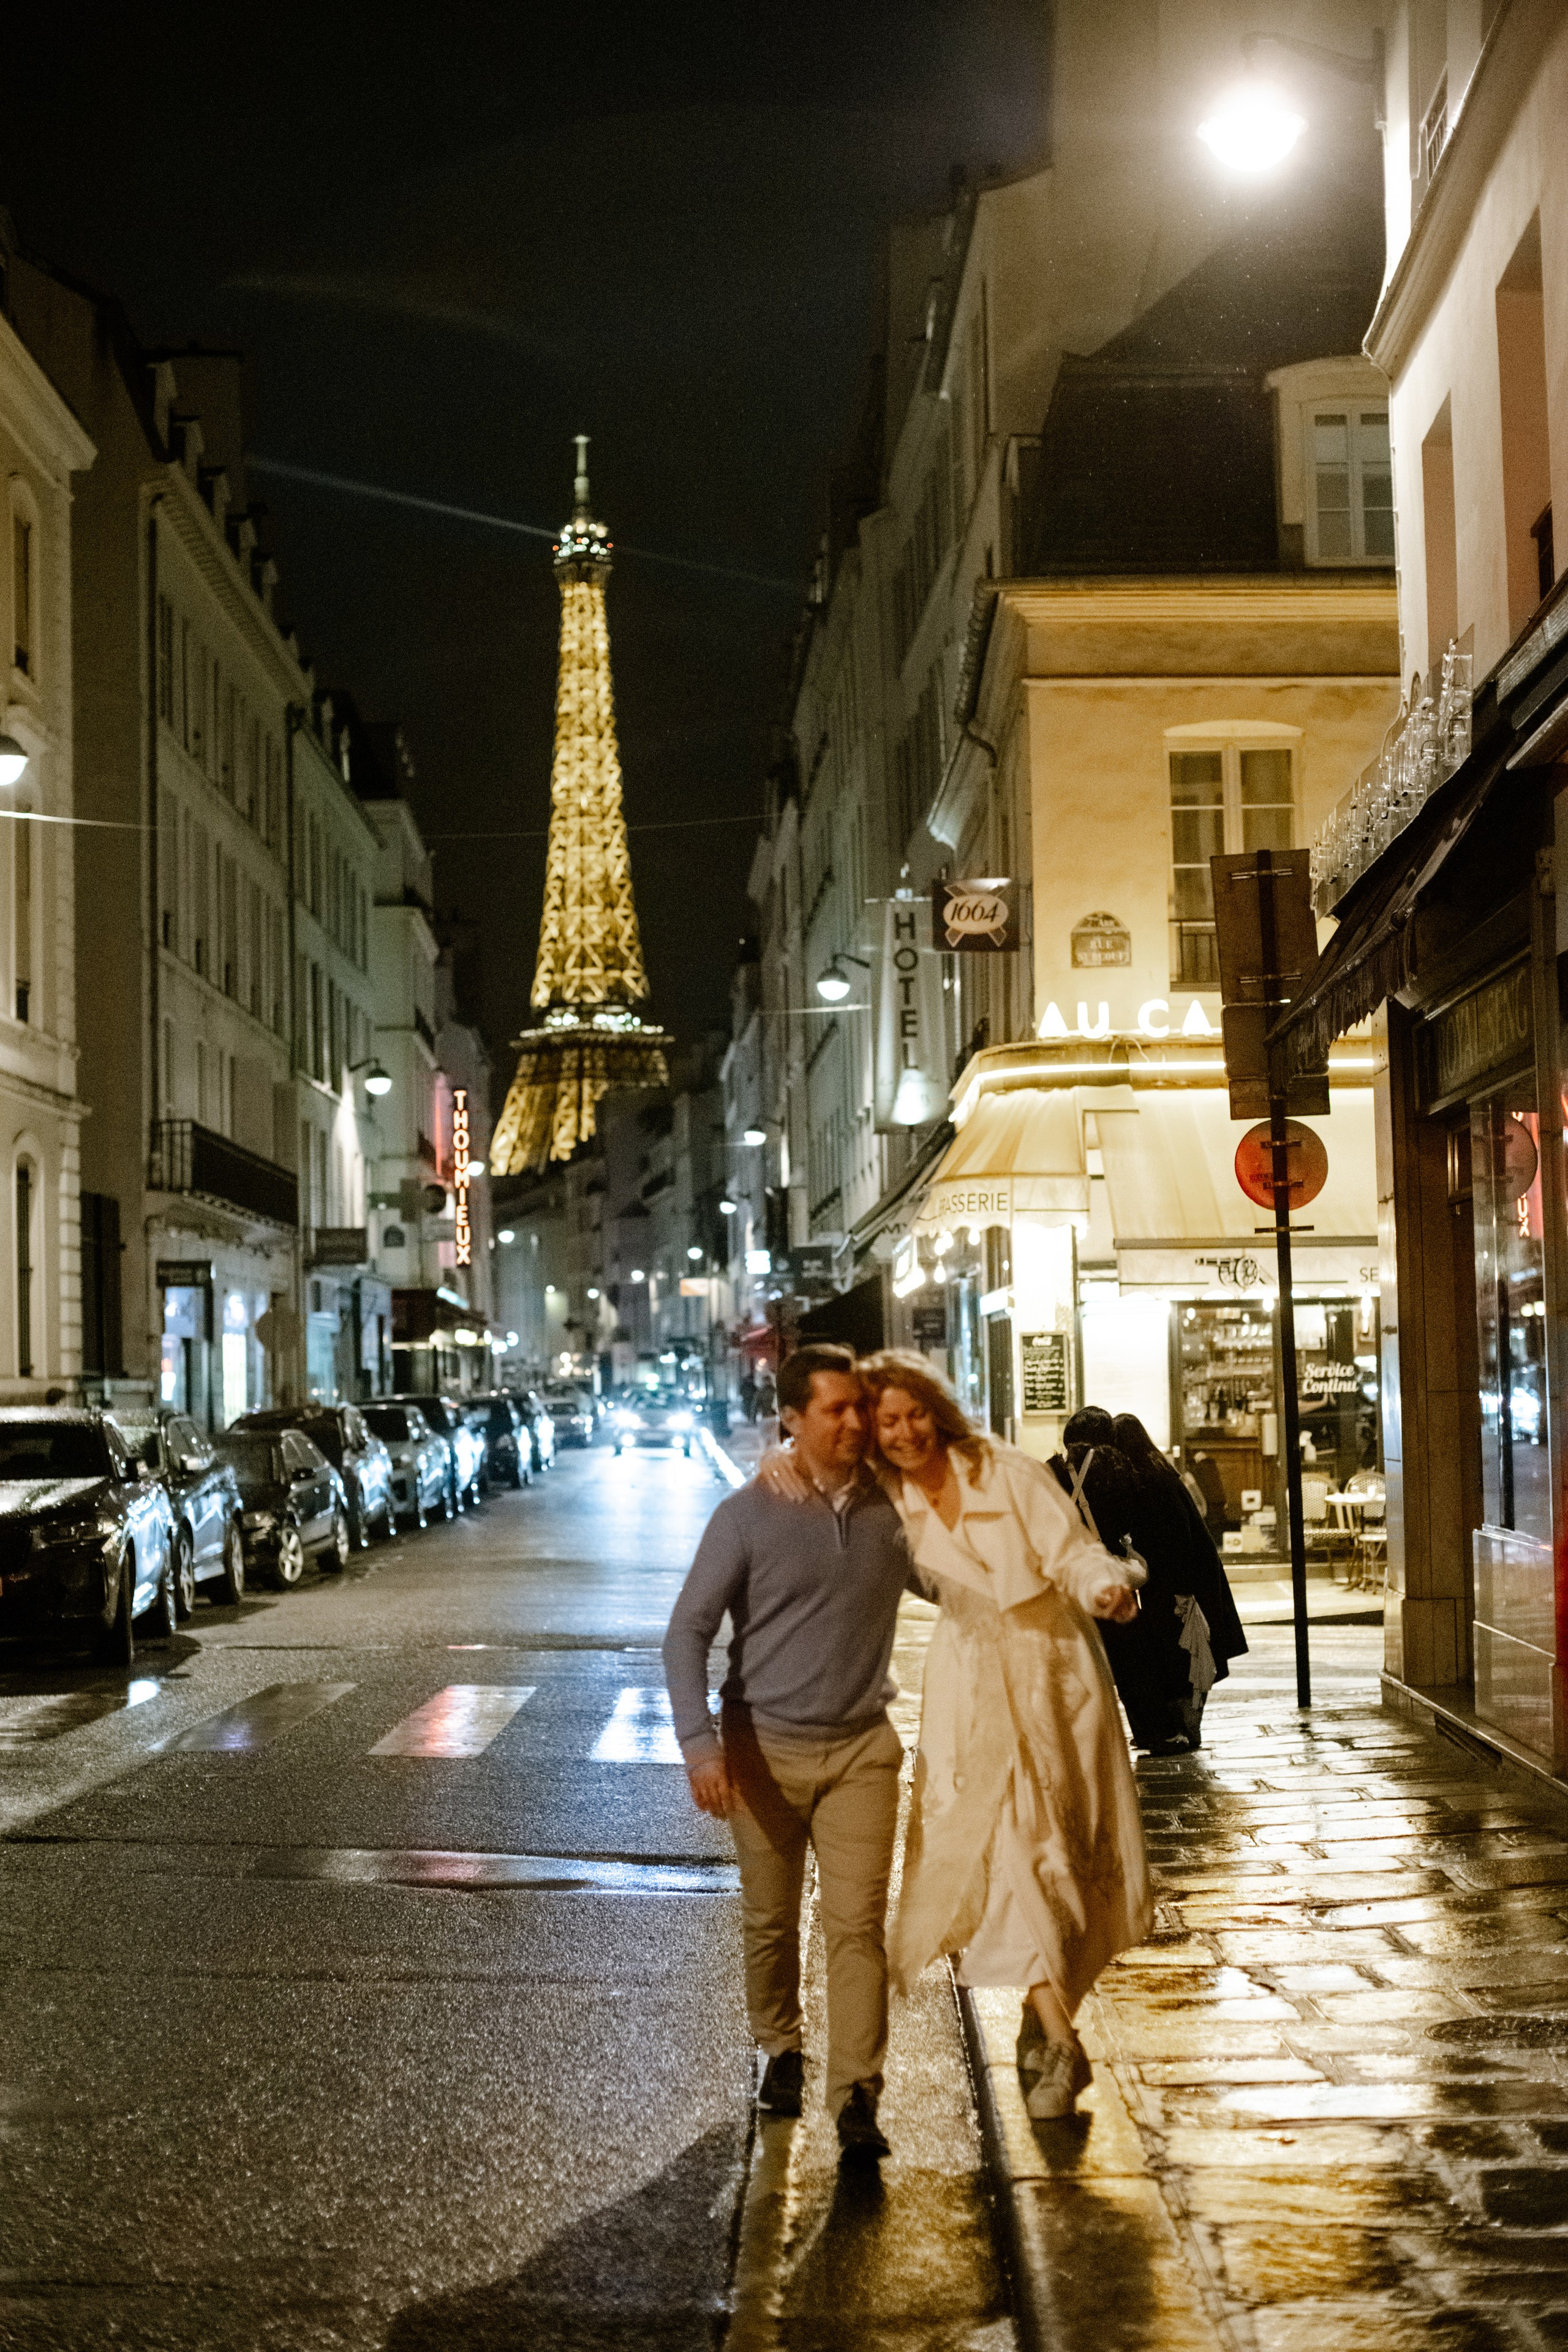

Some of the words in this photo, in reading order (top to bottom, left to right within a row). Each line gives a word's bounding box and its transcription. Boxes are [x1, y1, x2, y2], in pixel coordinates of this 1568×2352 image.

[951, 899, 1000, 922] 1664
[894, 912, 919, 1070] HOTEL
[1038, 1001, 1109, 1039] AU
[453, 1090, 470, 1265] THOUMIEUX
[1304, 1362, 1355, 1378] Service
[1302, 1378, 1359, 1393] Continu
